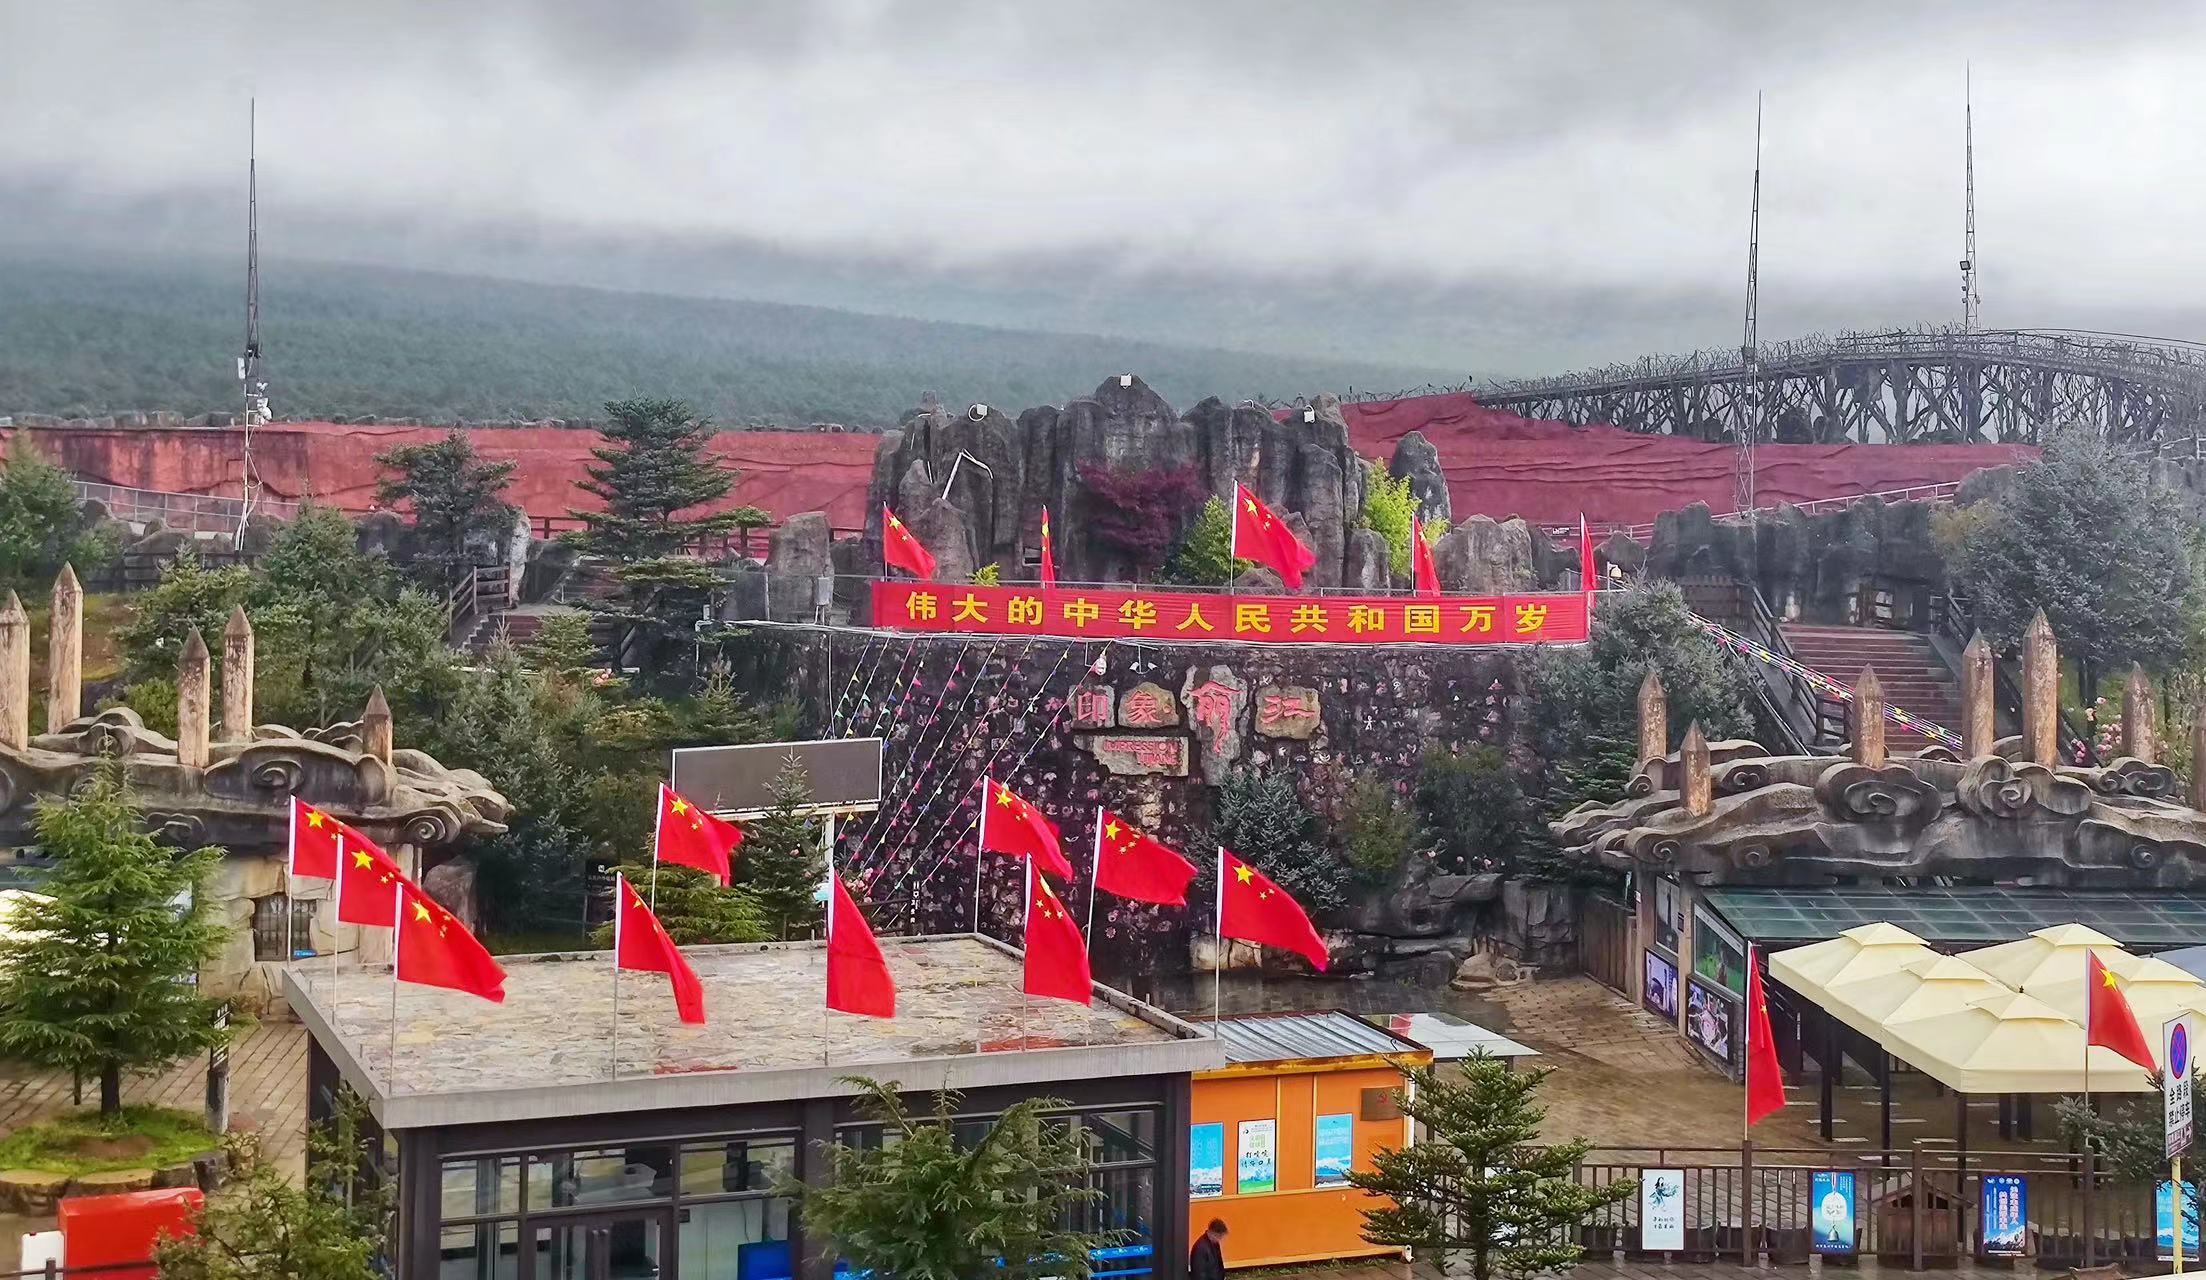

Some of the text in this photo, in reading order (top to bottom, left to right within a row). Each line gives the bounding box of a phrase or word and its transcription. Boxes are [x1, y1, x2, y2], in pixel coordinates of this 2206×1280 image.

[905, 590, 1548, 635] 伟大的中华人民共和国万岁
[1103, 740, 1178, 753] IMPRESSION
[2169, 1080, 2189, 1105] 全路段
[2168, 1101, 2190, 1128] 禁止停车
